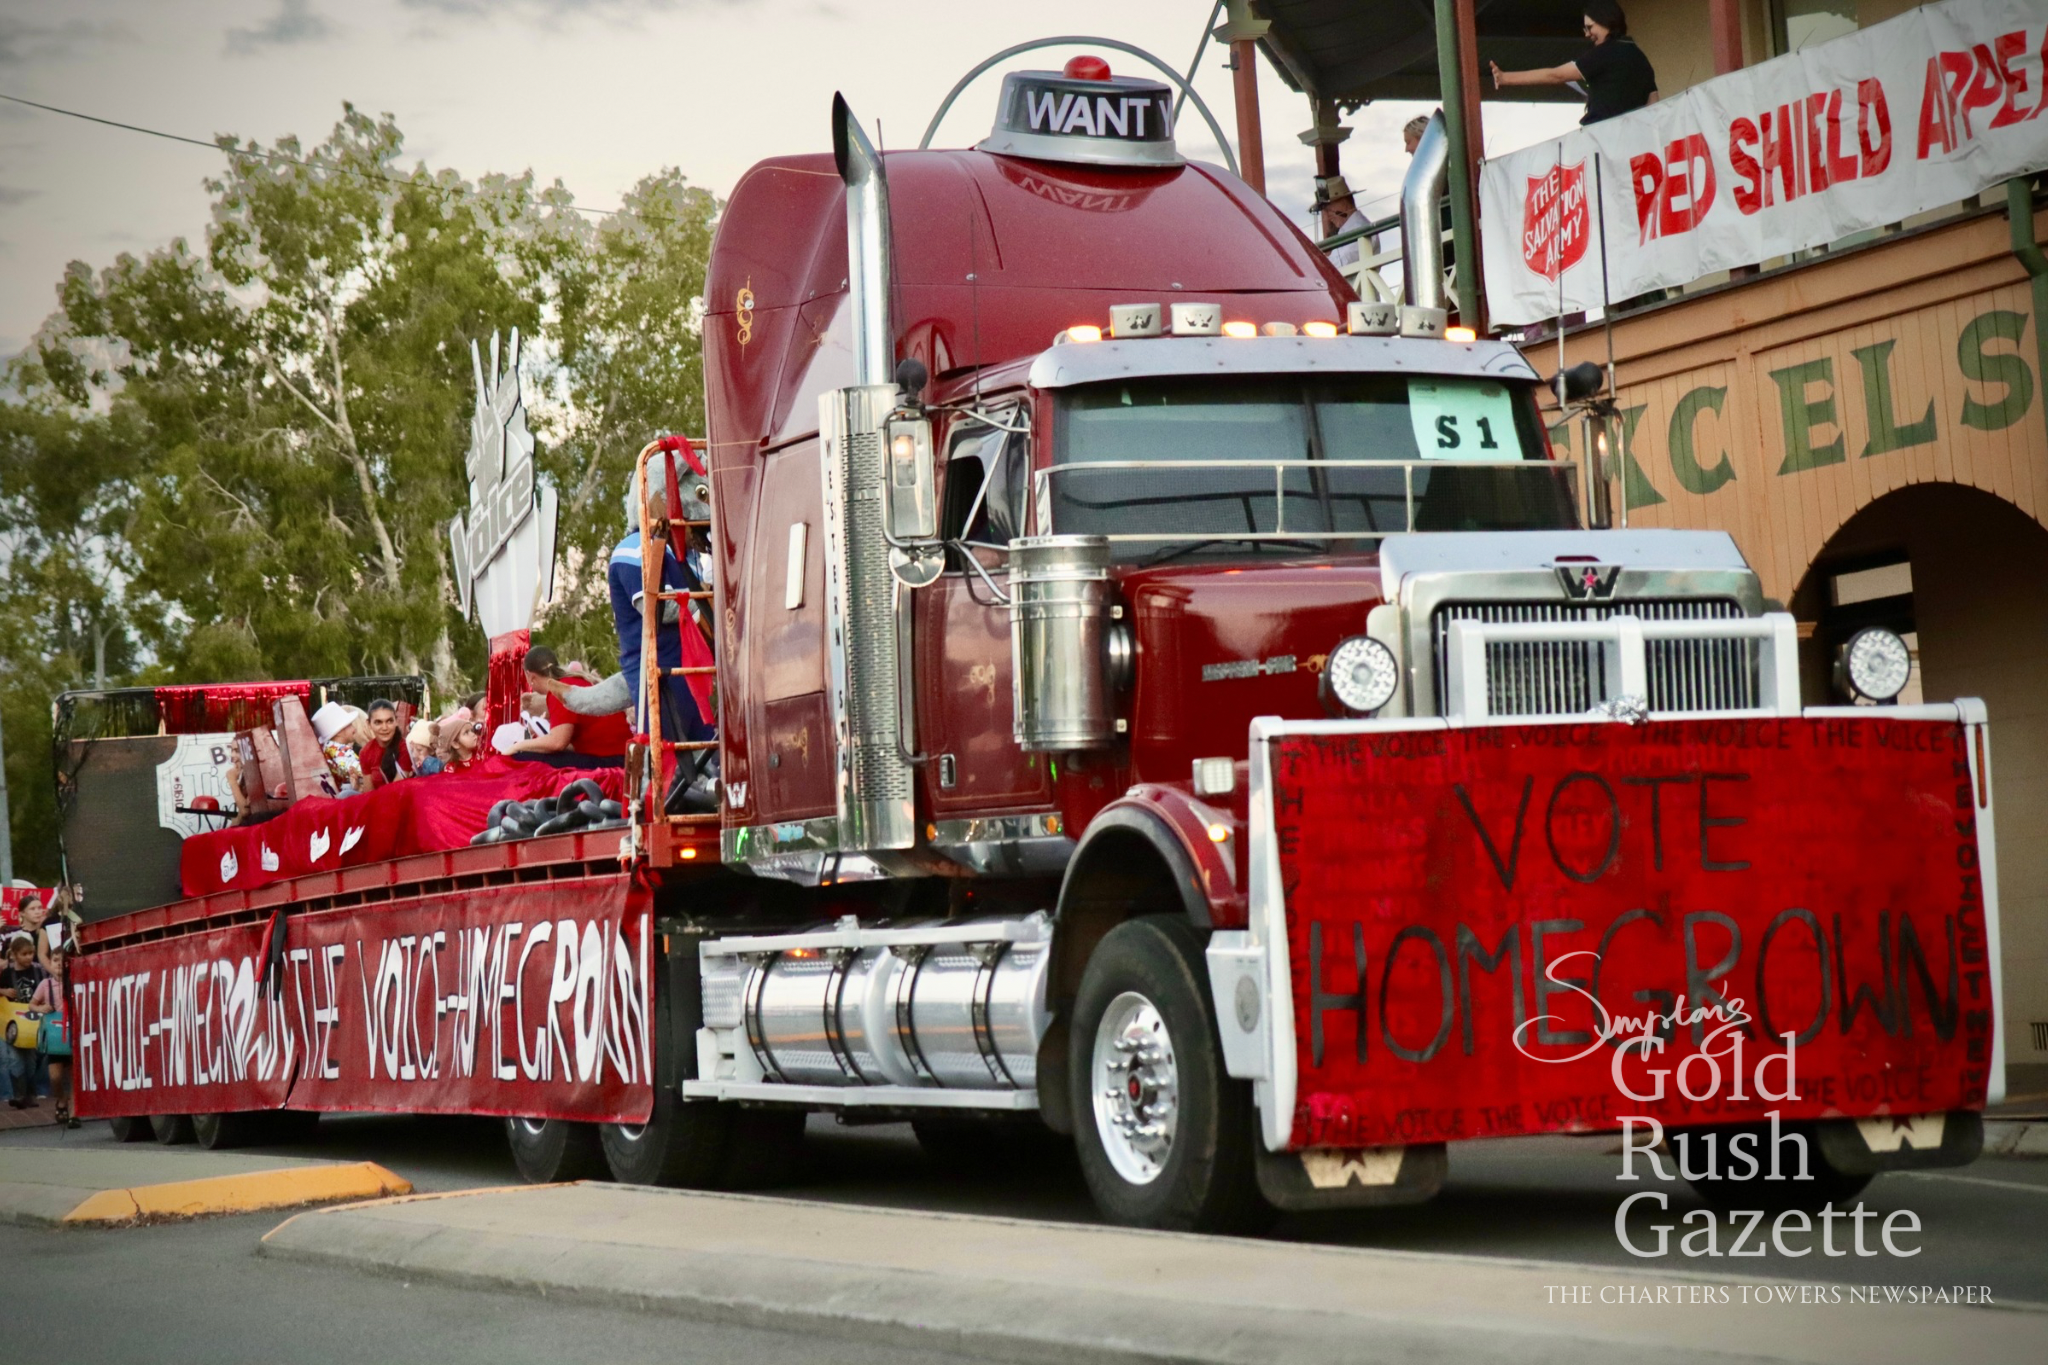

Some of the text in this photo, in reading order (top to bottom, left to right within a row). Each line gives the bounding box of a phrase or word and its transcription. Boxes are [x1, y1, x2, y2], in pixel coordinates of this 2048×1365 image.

[1027, 90, 1151, 137] WANT
[1630, 133, 1717, 247] RED
[1729, 77, 1892, 216] SHIELD
[1532, 169, 1560, 216] THE
[1545, 207, 1583, 274] ARMY
[1434, 415, 1498, 449] S 1
[1549, 309, 2036, 511] XCELS
[450, 454, 534, 623] Voice
[1699, 720, 1792, 749] VOICE
[1809, 719, 1862, 749] THE
[1454, 771, 1752, 893] VOTE
[290, 943, 345, 1080] THE
[1309, 906, 1958, 1068] HOMEGROWN
